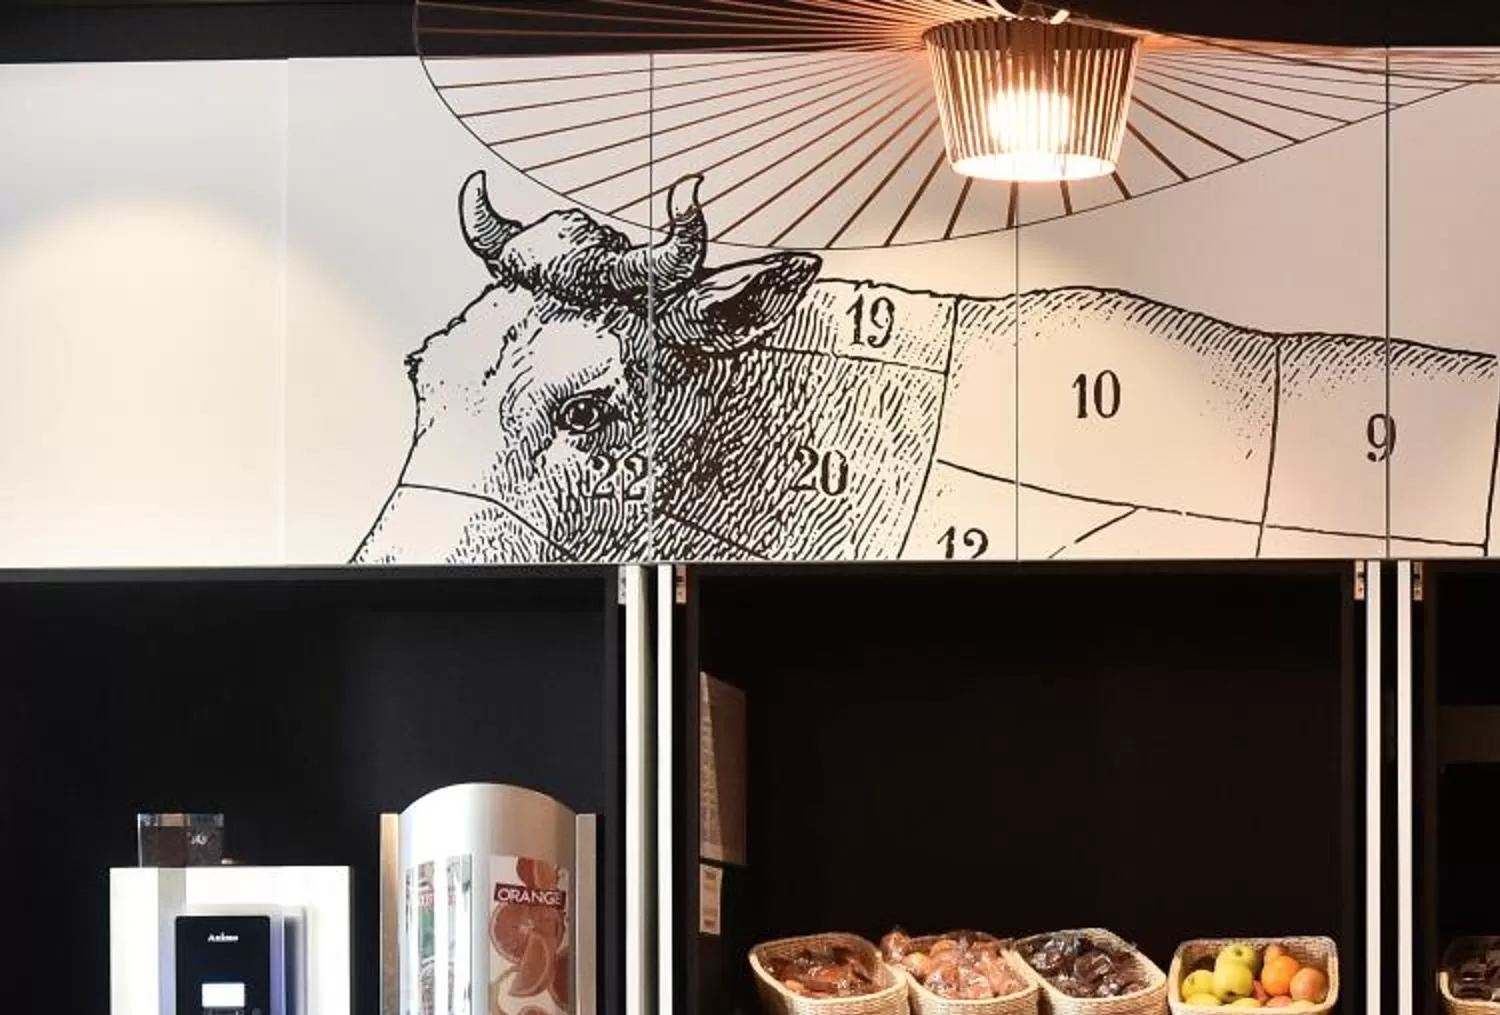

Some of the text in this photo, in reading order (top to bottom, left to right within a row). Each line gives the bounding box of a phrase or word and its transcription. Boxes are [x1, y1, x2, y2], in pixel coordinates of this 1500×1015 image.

[846, 294, 895, 349] 19
[1072, 369, 1121, 419] 10
[1367, 413, 1397, 463] 9
[591, 452, 649, 499] 22
[790, 447, 849, 496] 20
[497, 886, 562, 905] ORANGE
